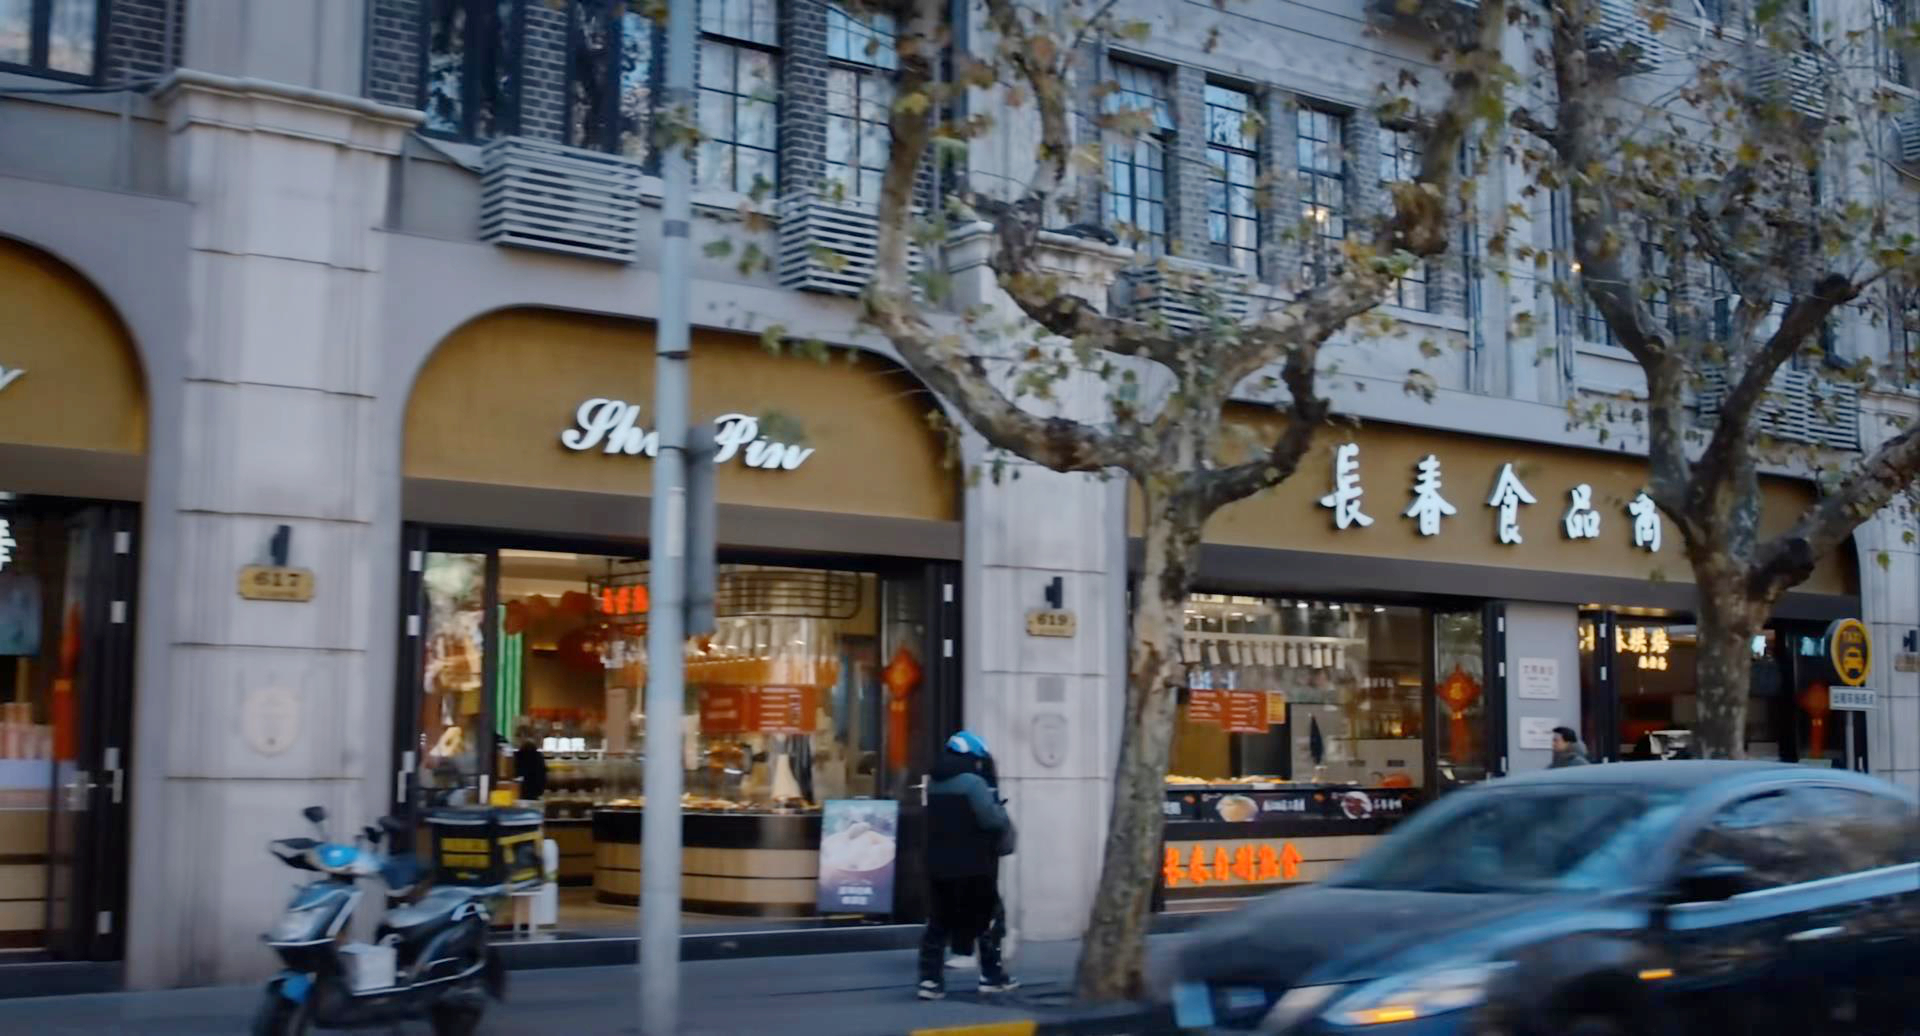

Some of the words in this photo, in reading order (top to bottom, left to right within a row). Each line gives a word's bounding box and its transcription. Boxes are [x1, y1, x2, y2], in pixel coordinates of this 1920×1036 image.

[713, 413, 816, 470] Pin
[254, 571, 301, 588] 617
[1037, 612, 1068, 626] 619
